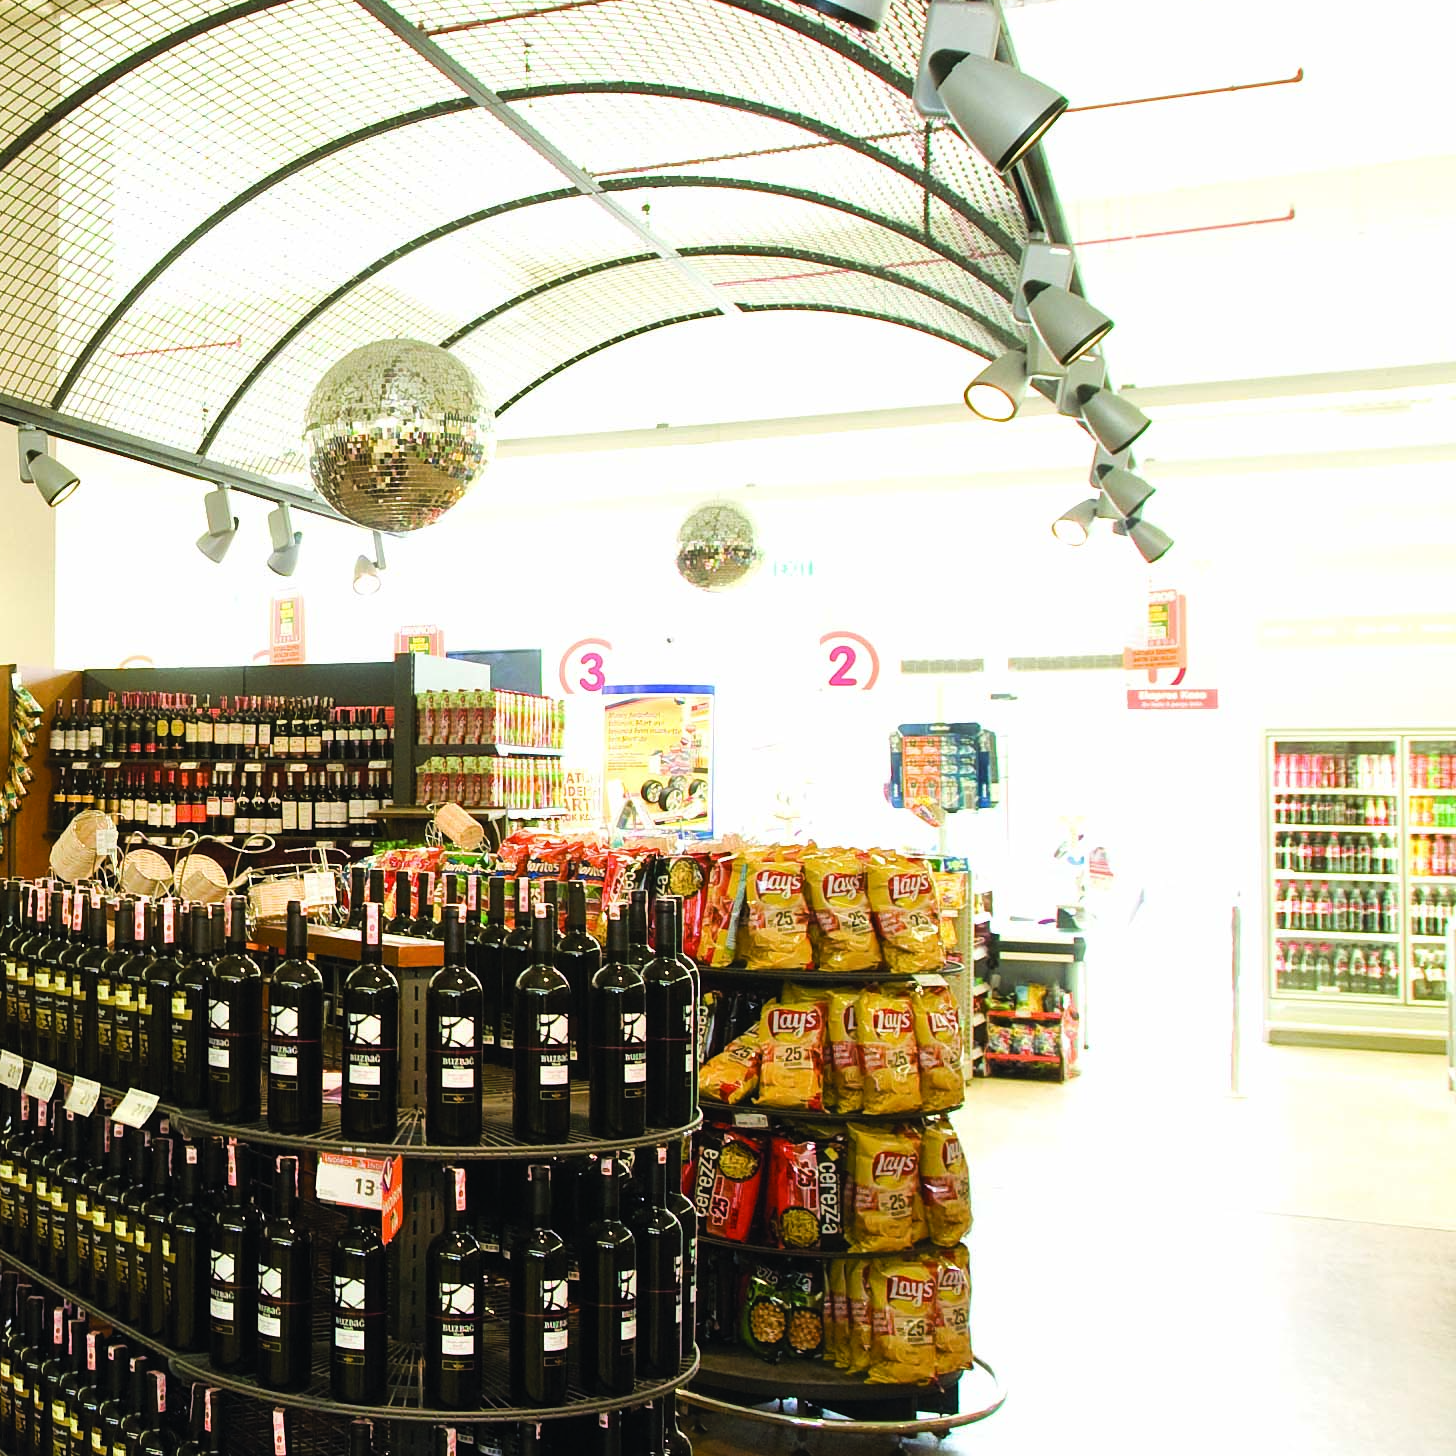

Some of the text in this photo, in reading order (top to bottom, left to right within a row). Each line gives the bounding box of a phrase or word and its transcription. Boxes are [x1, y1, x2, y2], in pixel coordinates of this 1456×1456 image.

[580, 653, 605, 691] 3
[829, 645, 857, 686] 2
[776, 910, 794, 927] 25
[850, 910, 867, 926] 25
[785, 1046, 802, 1062] 25
[355, 1178, 376, 1197] 13
[888, 1194, 906, 1209] 25
[907, 1322, 925, 1337] 25
